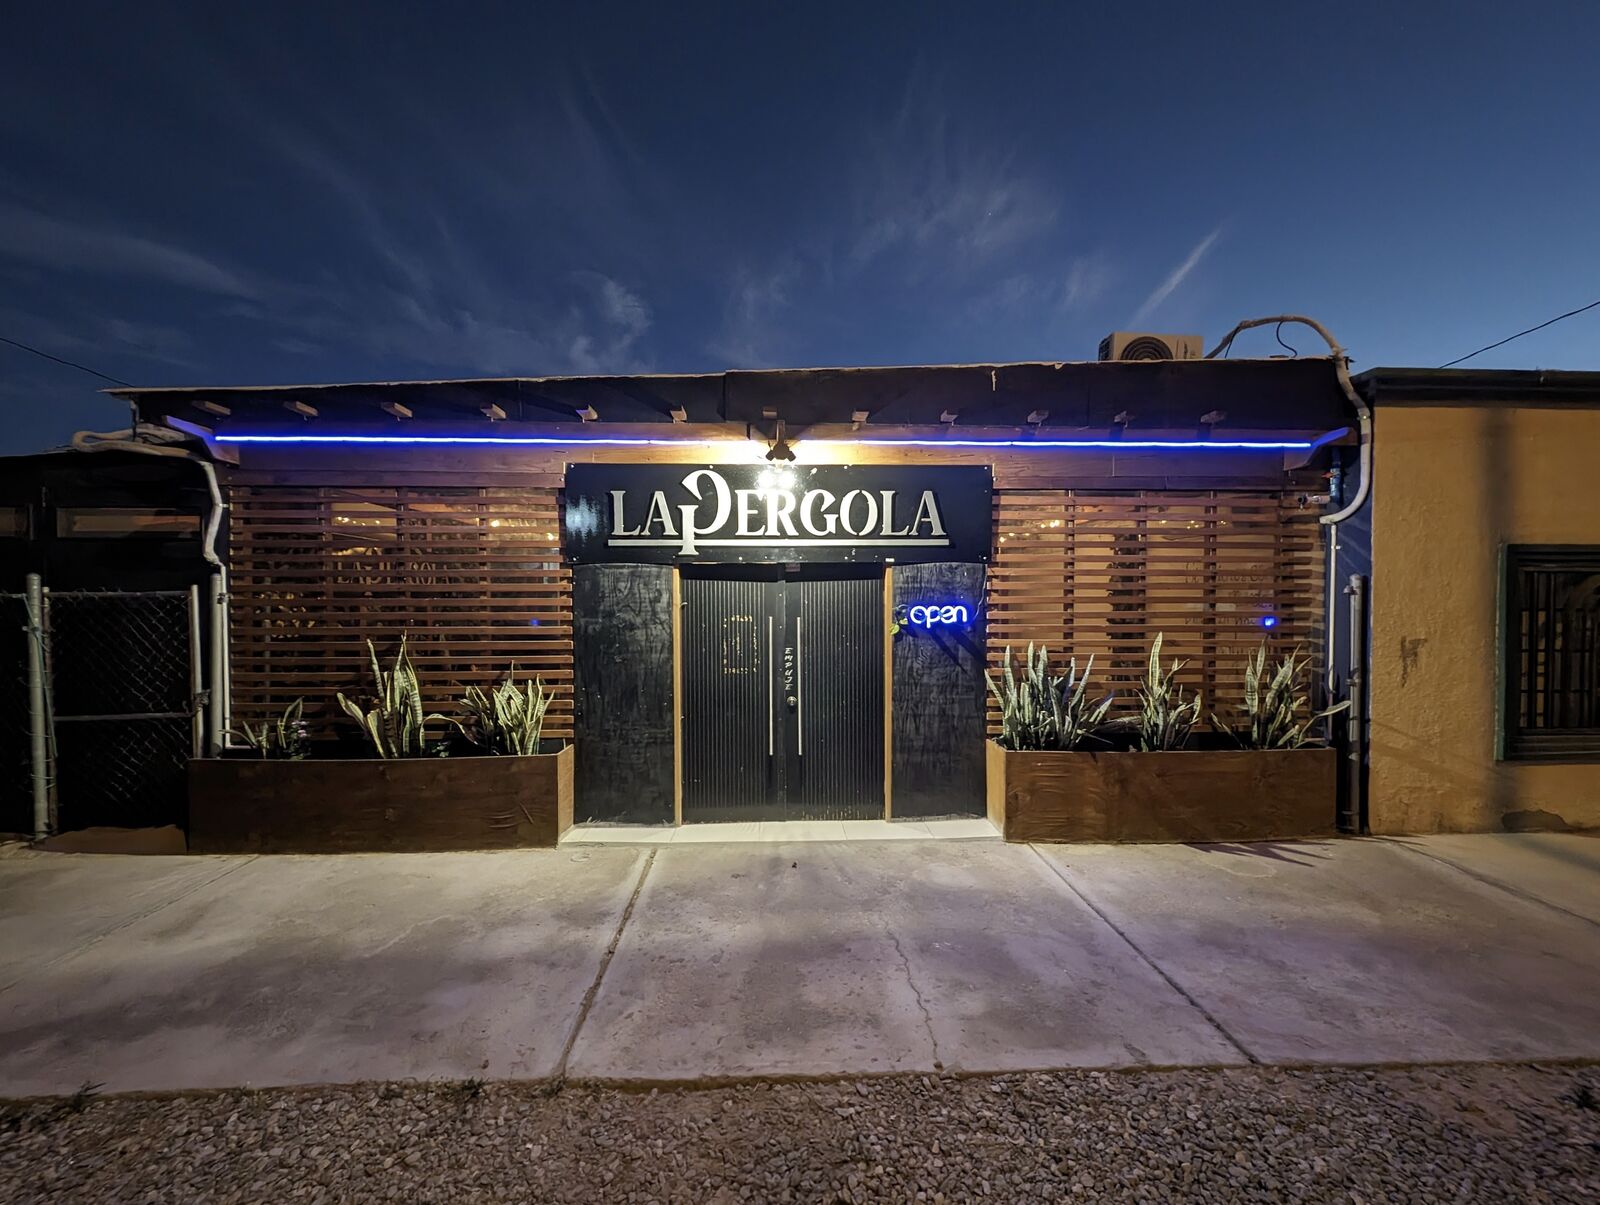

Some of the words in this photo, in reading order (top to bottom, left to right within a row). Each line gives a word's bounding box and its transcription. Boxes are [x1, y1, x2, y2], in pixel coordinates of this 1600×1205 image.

[610, 490, 679, 536] LA
[677, 469, 947, 555] PERGOLA
[910, 605, 967, 629] open
[784, 647, 794, 690] EMPUJE
